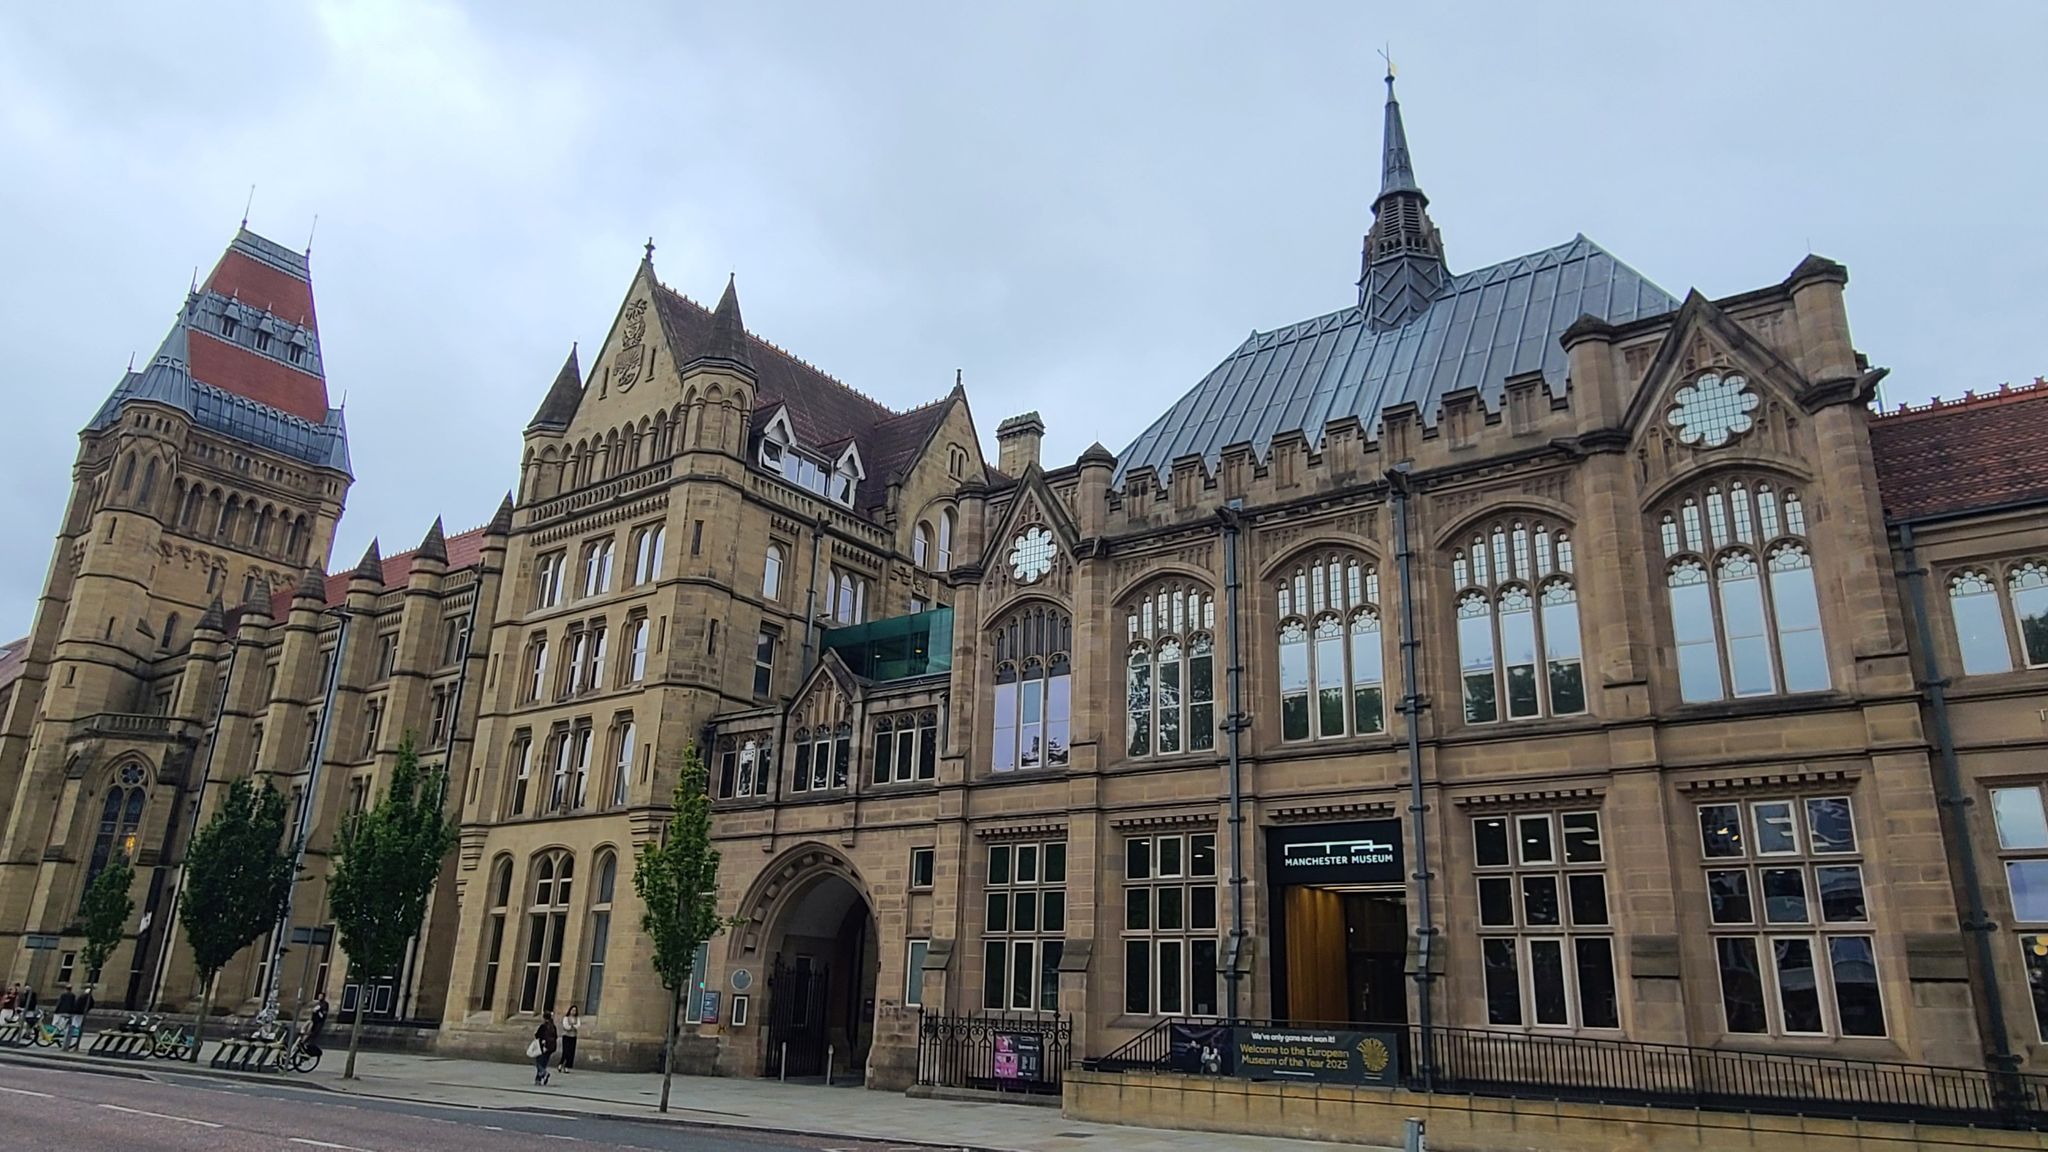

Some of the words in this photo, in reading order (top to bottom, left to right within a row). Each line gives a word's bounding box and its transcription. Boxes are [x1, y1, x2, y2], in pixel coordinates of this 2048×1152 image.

[1285, 856, 1348, 866] MANCHESTER
[1351, 854, 1393, 864] MUSEUM
[1271, 1033, 1284, 1043] only
[1285, 1035, 1300, 1043] gone
[1301, 1034, 1313, 1042] and
[1240, 1043, 1278, 1055] Welcome
[1280, 1046, 1290, 1055] to
[1291, 1046, 1305, 1056] the
[1307, 1046, 1349, 1059] European
[1241, 1054, 1277, 1065] Museum
[1279, 1056, 1288, 1066] of
[1289, 1057, 1304, 1067] the
[1304, 1058, 1324, 1068] Year
[1326, 1060, 1348, 1070] 2025
